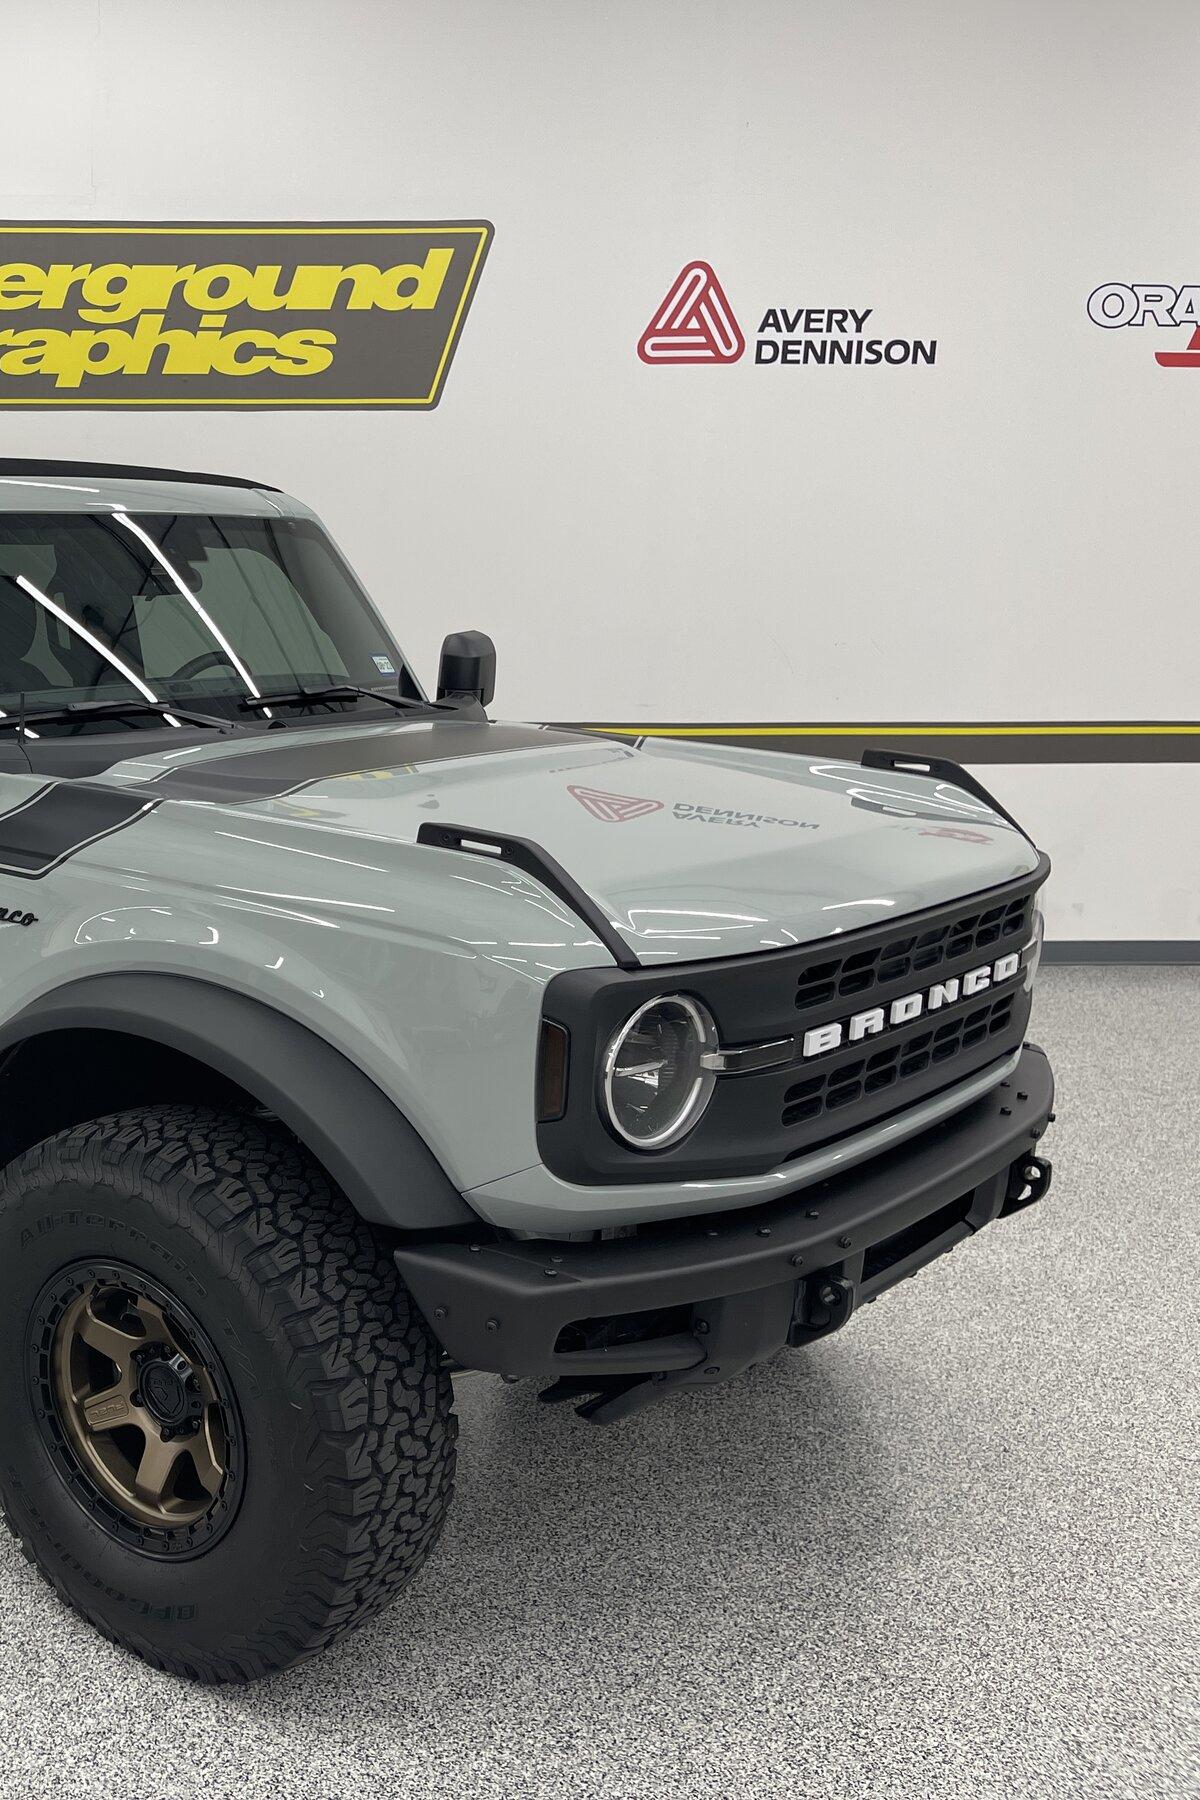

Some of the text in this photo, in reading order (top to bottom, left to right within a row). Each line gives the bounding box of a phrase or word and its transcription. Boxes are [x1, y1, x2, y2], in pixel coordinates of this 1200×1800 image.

[758, 309, 873, 333] AVERY
[754, 340, 938, 365] DENNISON
[803, 952, 1019, 1057] BRONCO
